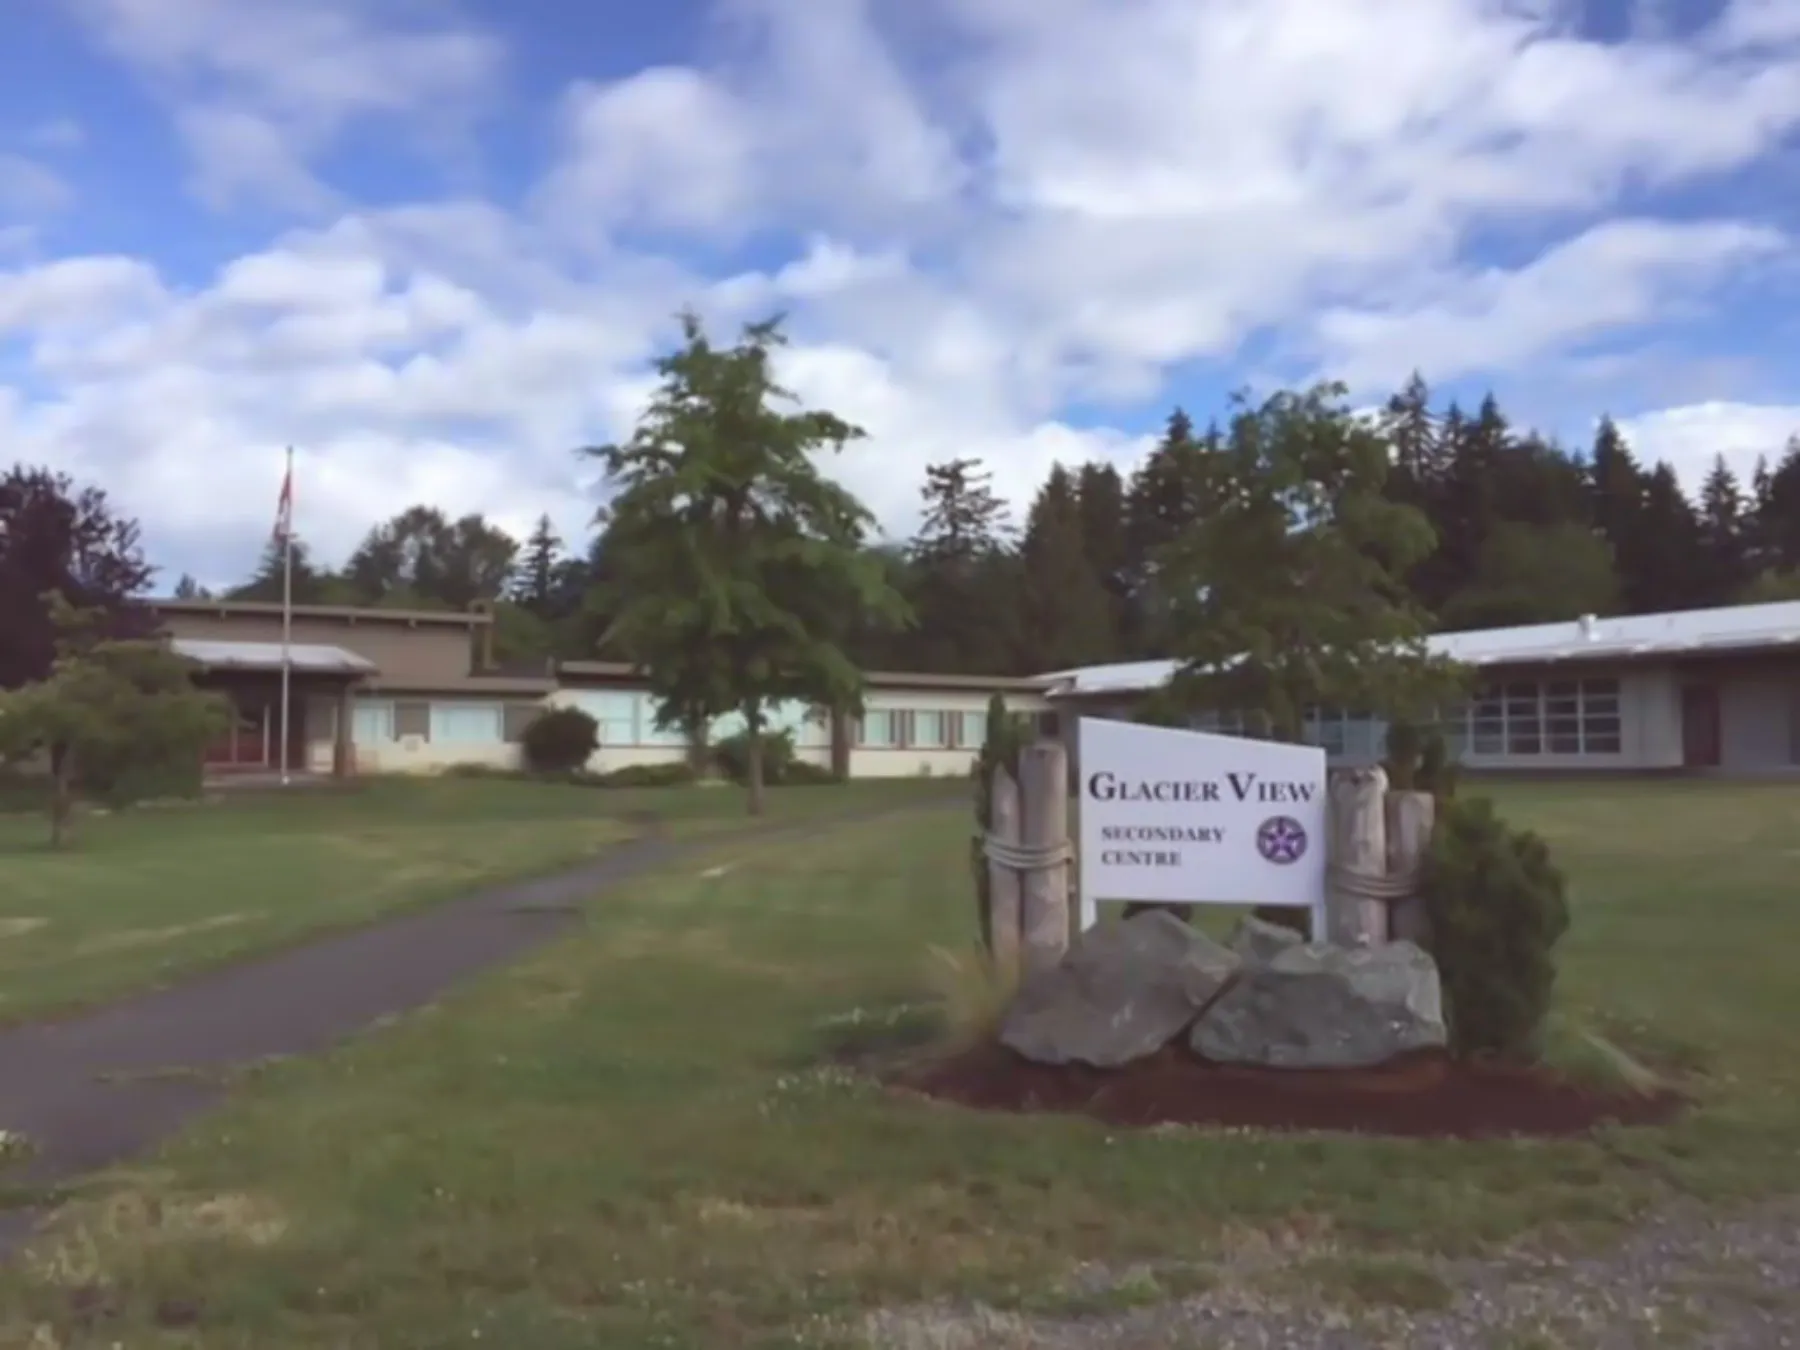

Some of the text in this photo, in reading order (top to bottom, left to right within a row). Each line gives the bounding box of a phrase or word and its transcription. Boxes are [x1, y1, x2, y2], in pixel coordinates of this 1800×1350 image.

[1088, 771, 1316, 803] GLACIER VIEW
[1101, 825, 1225, 844] SECONDARY
[1101, 850, 1182, 867] CENTRE
